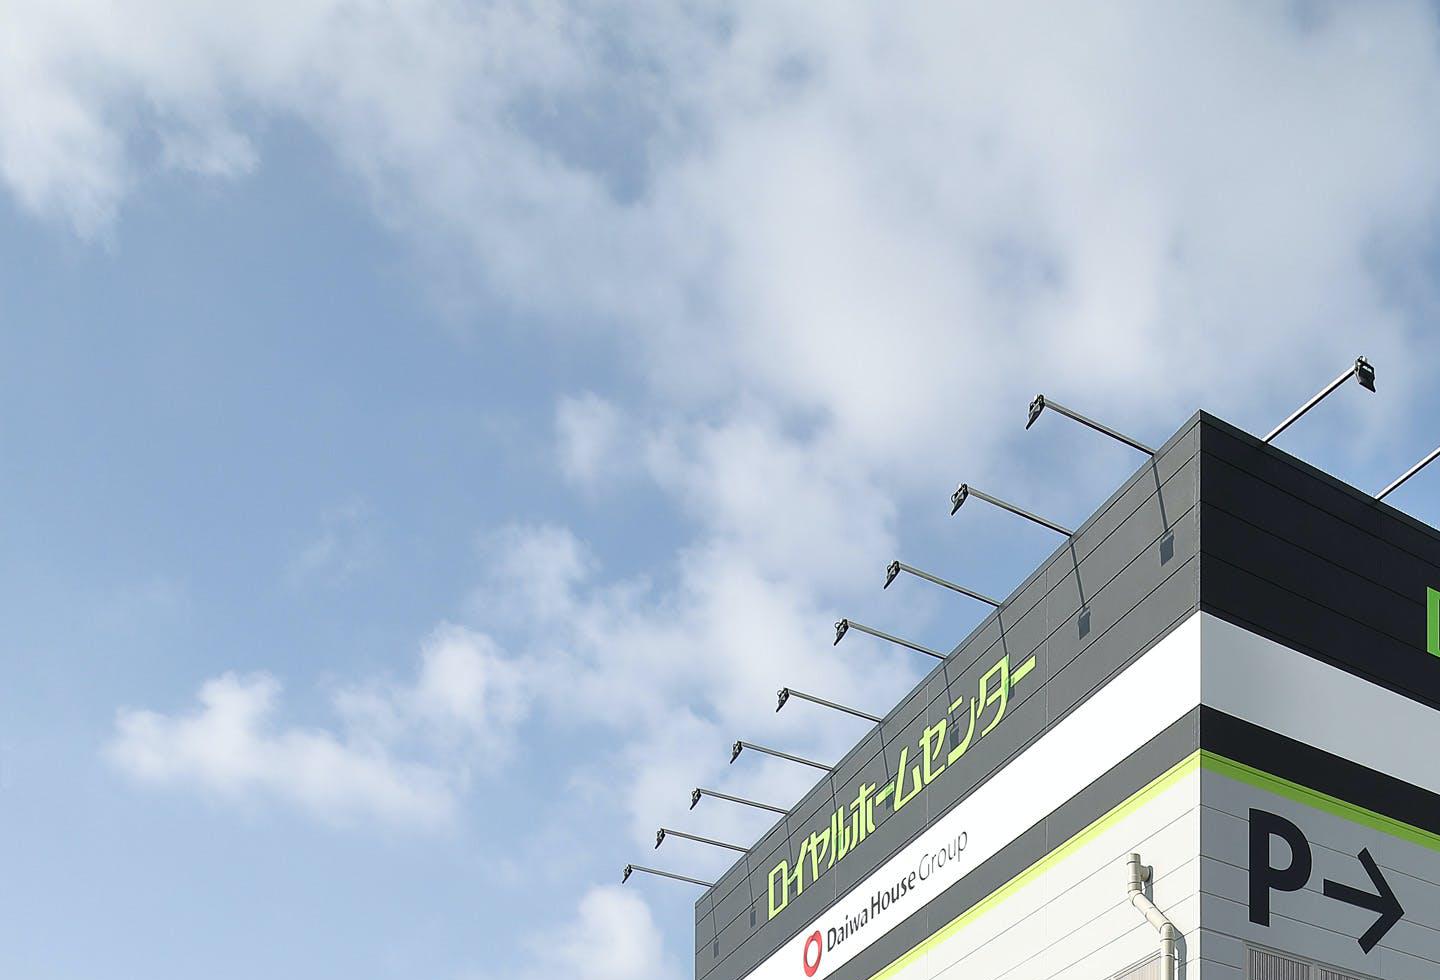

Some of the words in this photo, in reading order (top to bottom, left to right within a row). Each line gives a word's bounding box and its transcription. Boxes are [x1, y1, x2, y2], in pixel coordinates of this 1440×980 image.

[767, 654, 1036, 921] ロイヤルホームセンター
[1248, 807, 1312, 928] P
